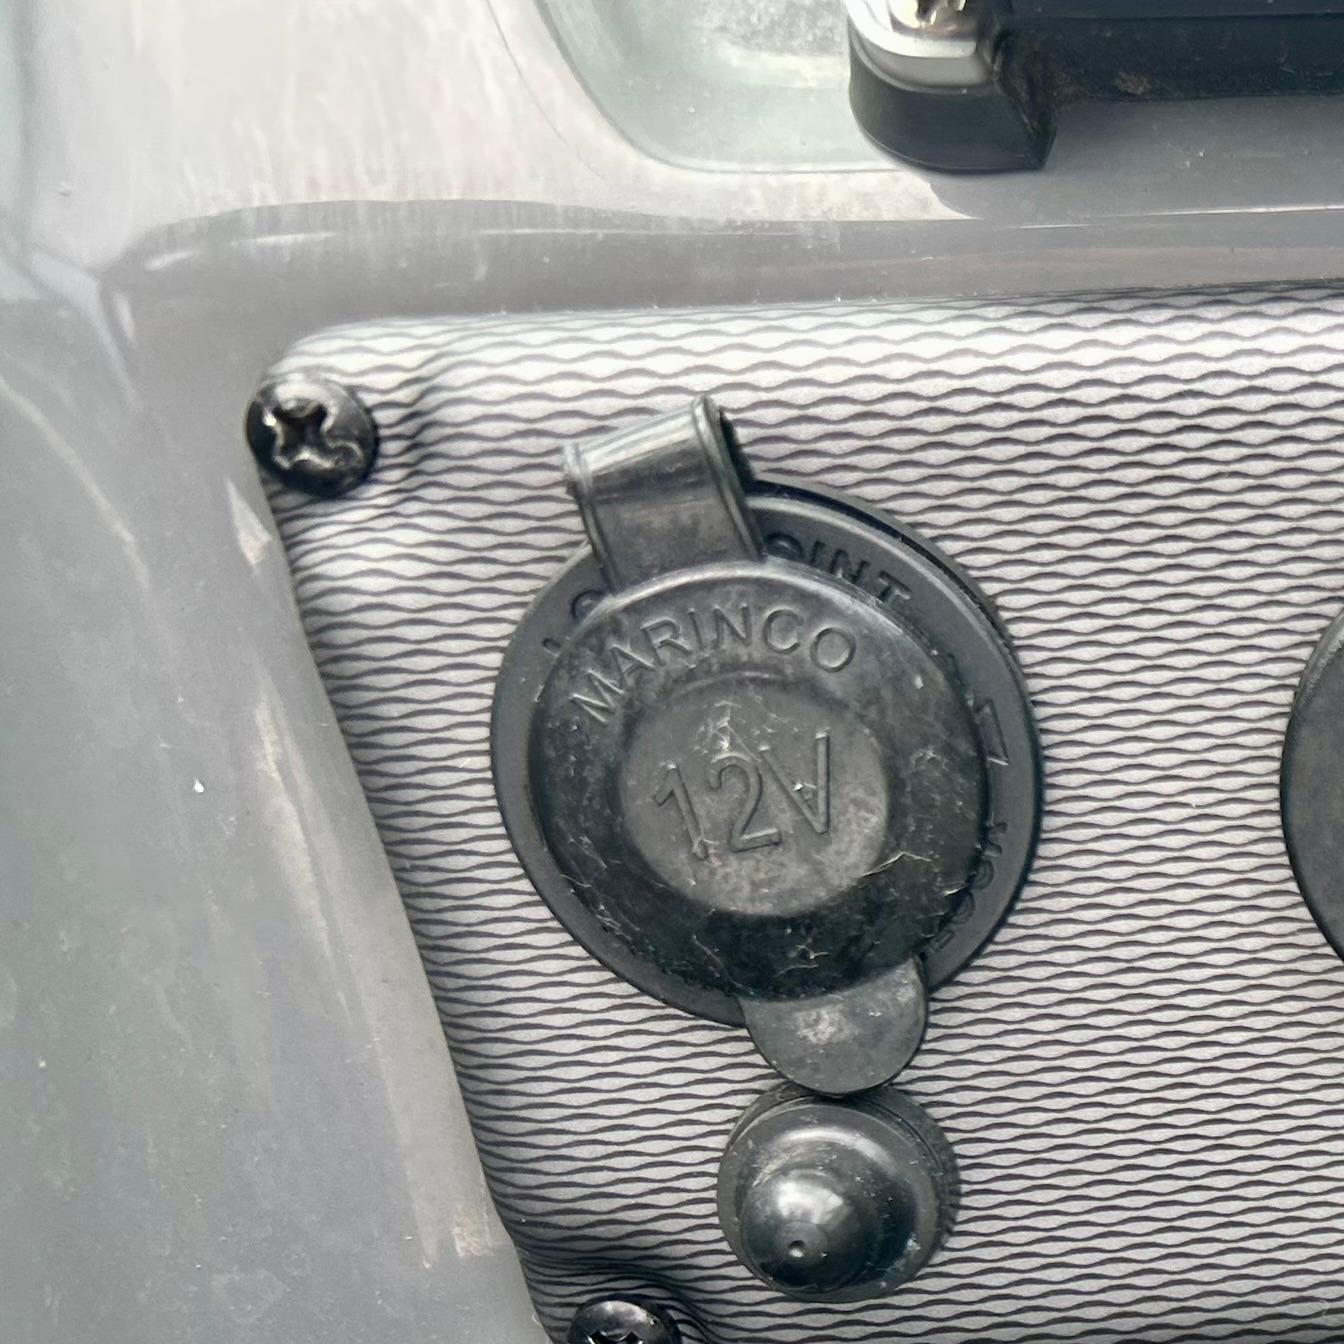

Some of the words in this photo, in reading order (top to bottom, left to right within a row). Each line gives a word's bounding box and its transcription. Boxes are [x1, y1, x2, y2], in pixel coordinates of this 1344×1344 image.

[764, 532, 914, 603] OINT
[567, 604, 857, 724] MARINCO
[652, 727, 832, 861] 12V
